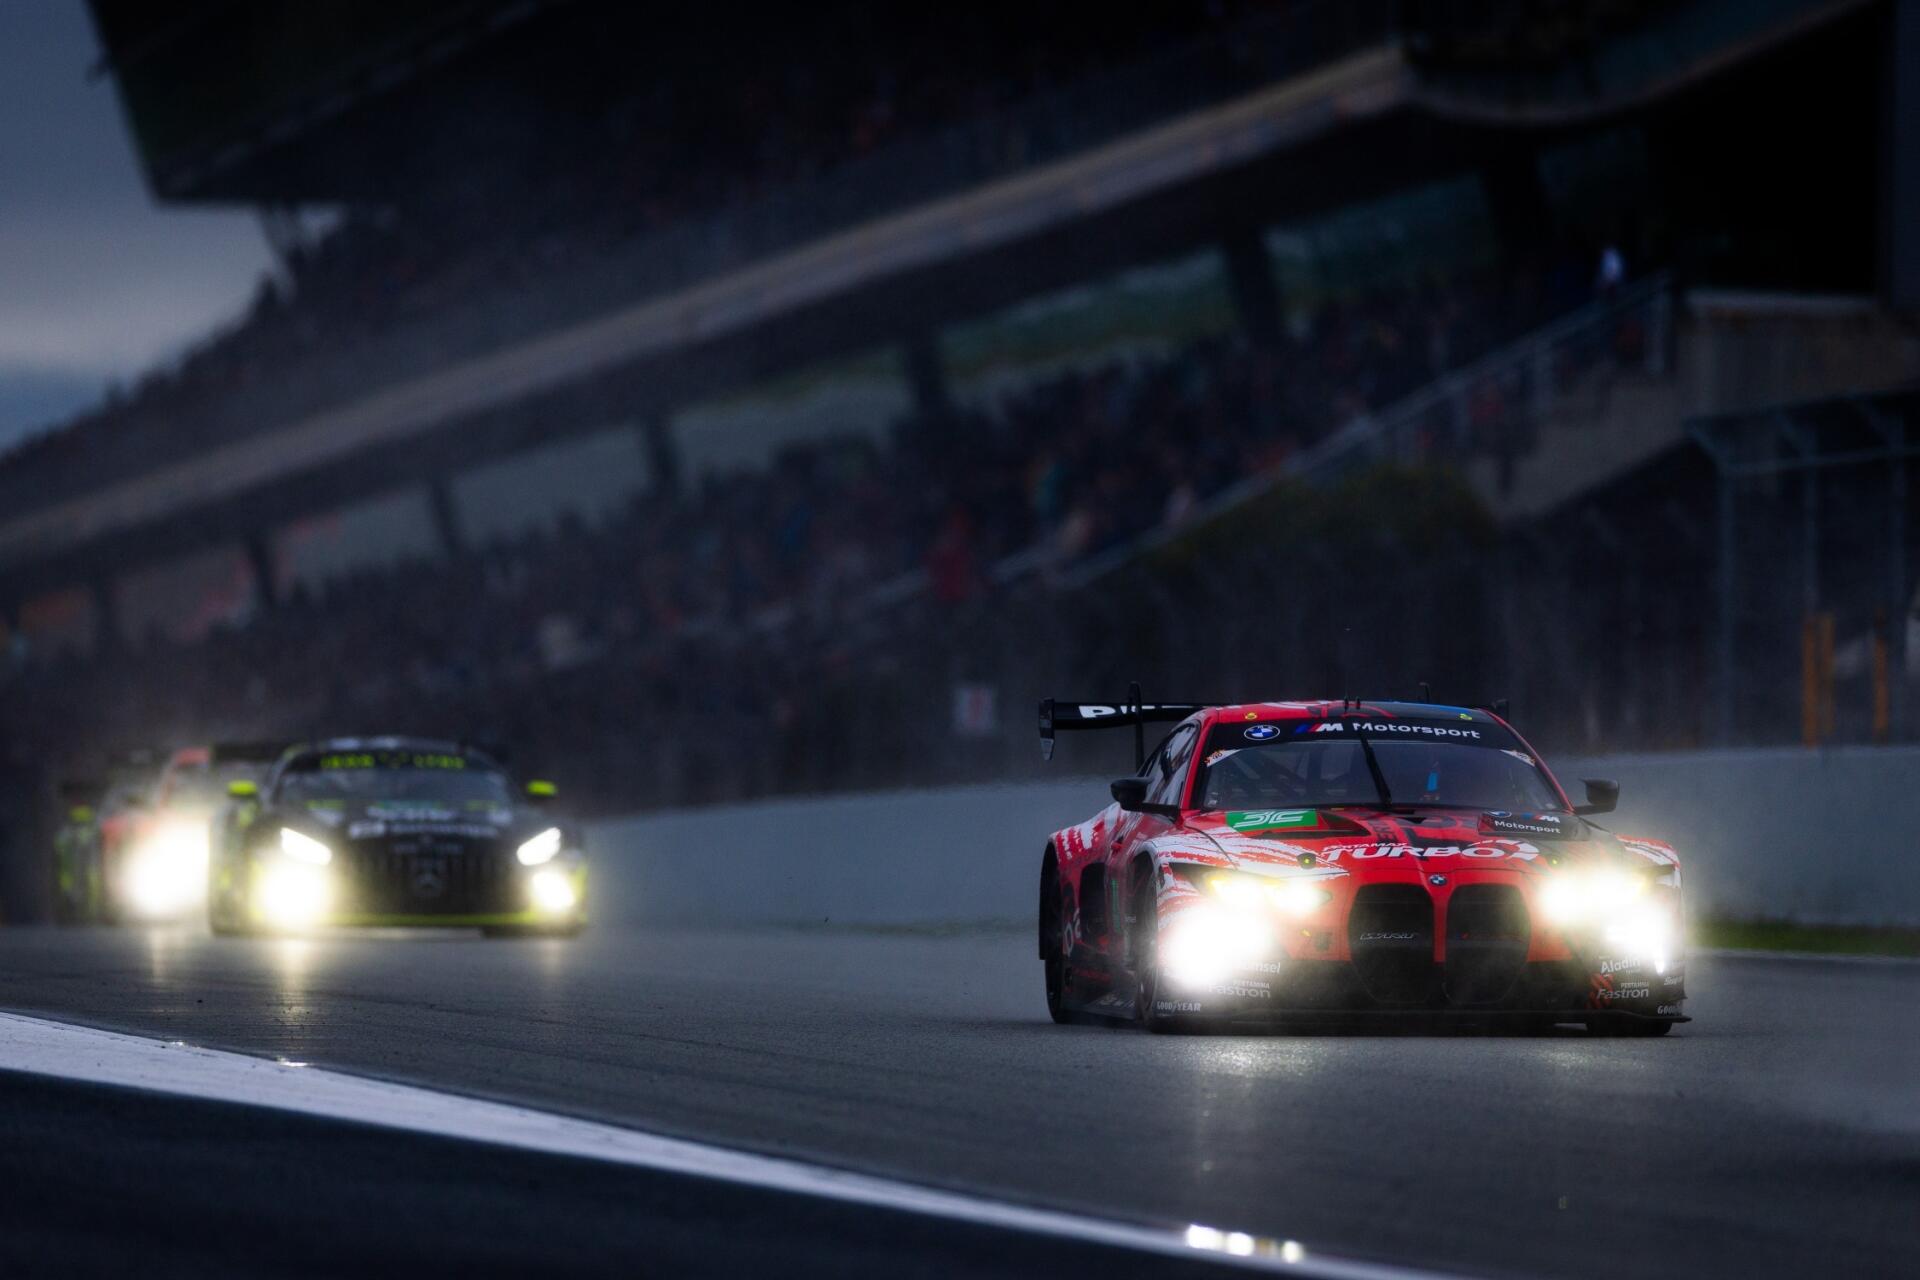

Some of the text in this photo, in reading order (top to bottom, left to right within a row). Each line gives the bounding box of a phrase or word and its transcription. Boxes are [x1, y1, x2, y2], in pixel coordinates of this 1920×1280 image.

[1353, 722, 1481, 739] Motorsport
[1494, 820, 1561, 833] Motorsport
[1597, 988, 1650, 999] Fastron
